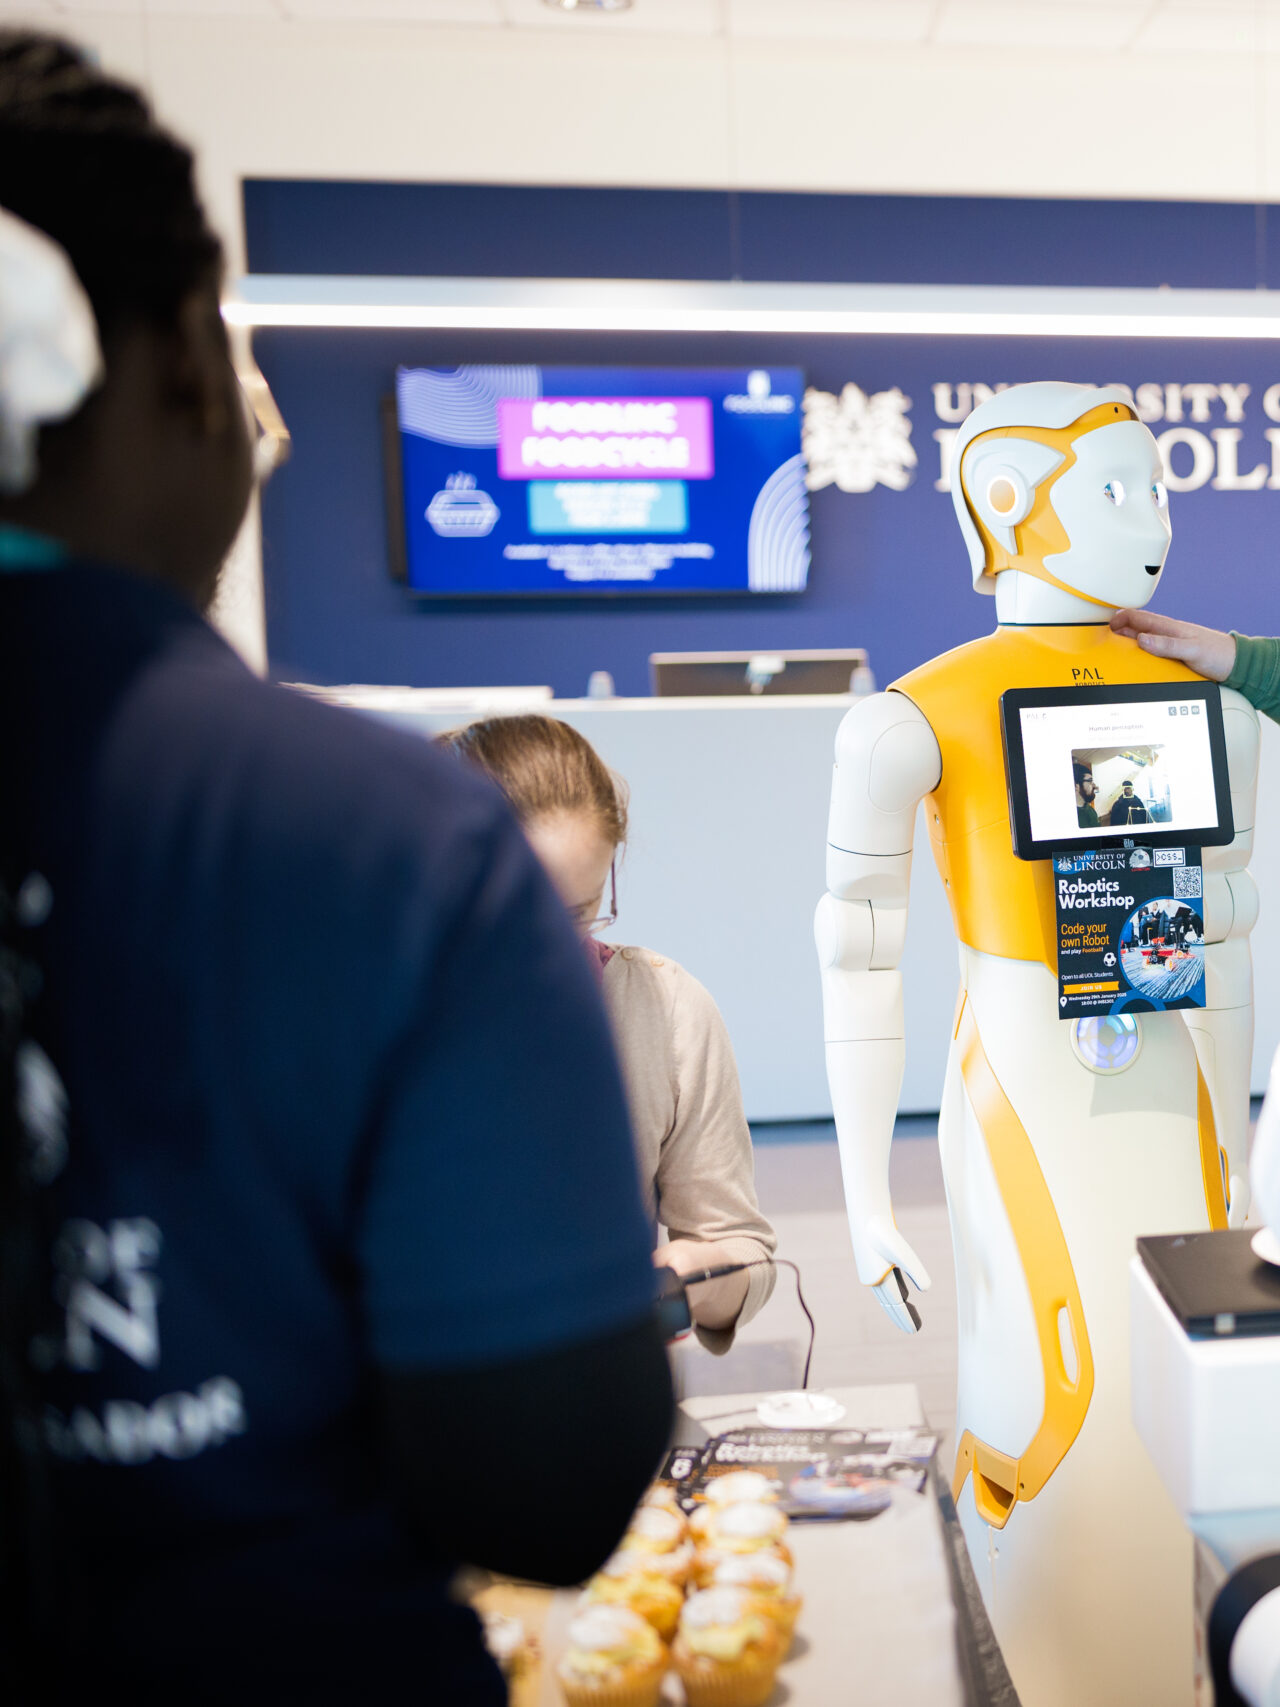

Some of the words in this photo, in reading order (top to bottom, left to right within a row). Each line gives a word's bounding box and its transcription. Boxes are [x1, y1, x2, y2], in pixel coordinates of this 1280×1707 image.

[932, 382, 1250, 423] USITY
[1073, 853, 1115, 861] UNIVERSITY
[1074, 860, 1126, 871] LINCOLN
[1058, 877, 1120, 894] Robotics
[1058, 892, 1135, 910] Workshop
[1061, 922, 1085, 935] Code
[1086, 923, 1107, 936] your
[1061, 938, 1080, 948] own
[1082, 934, 1110, 946] Robot
